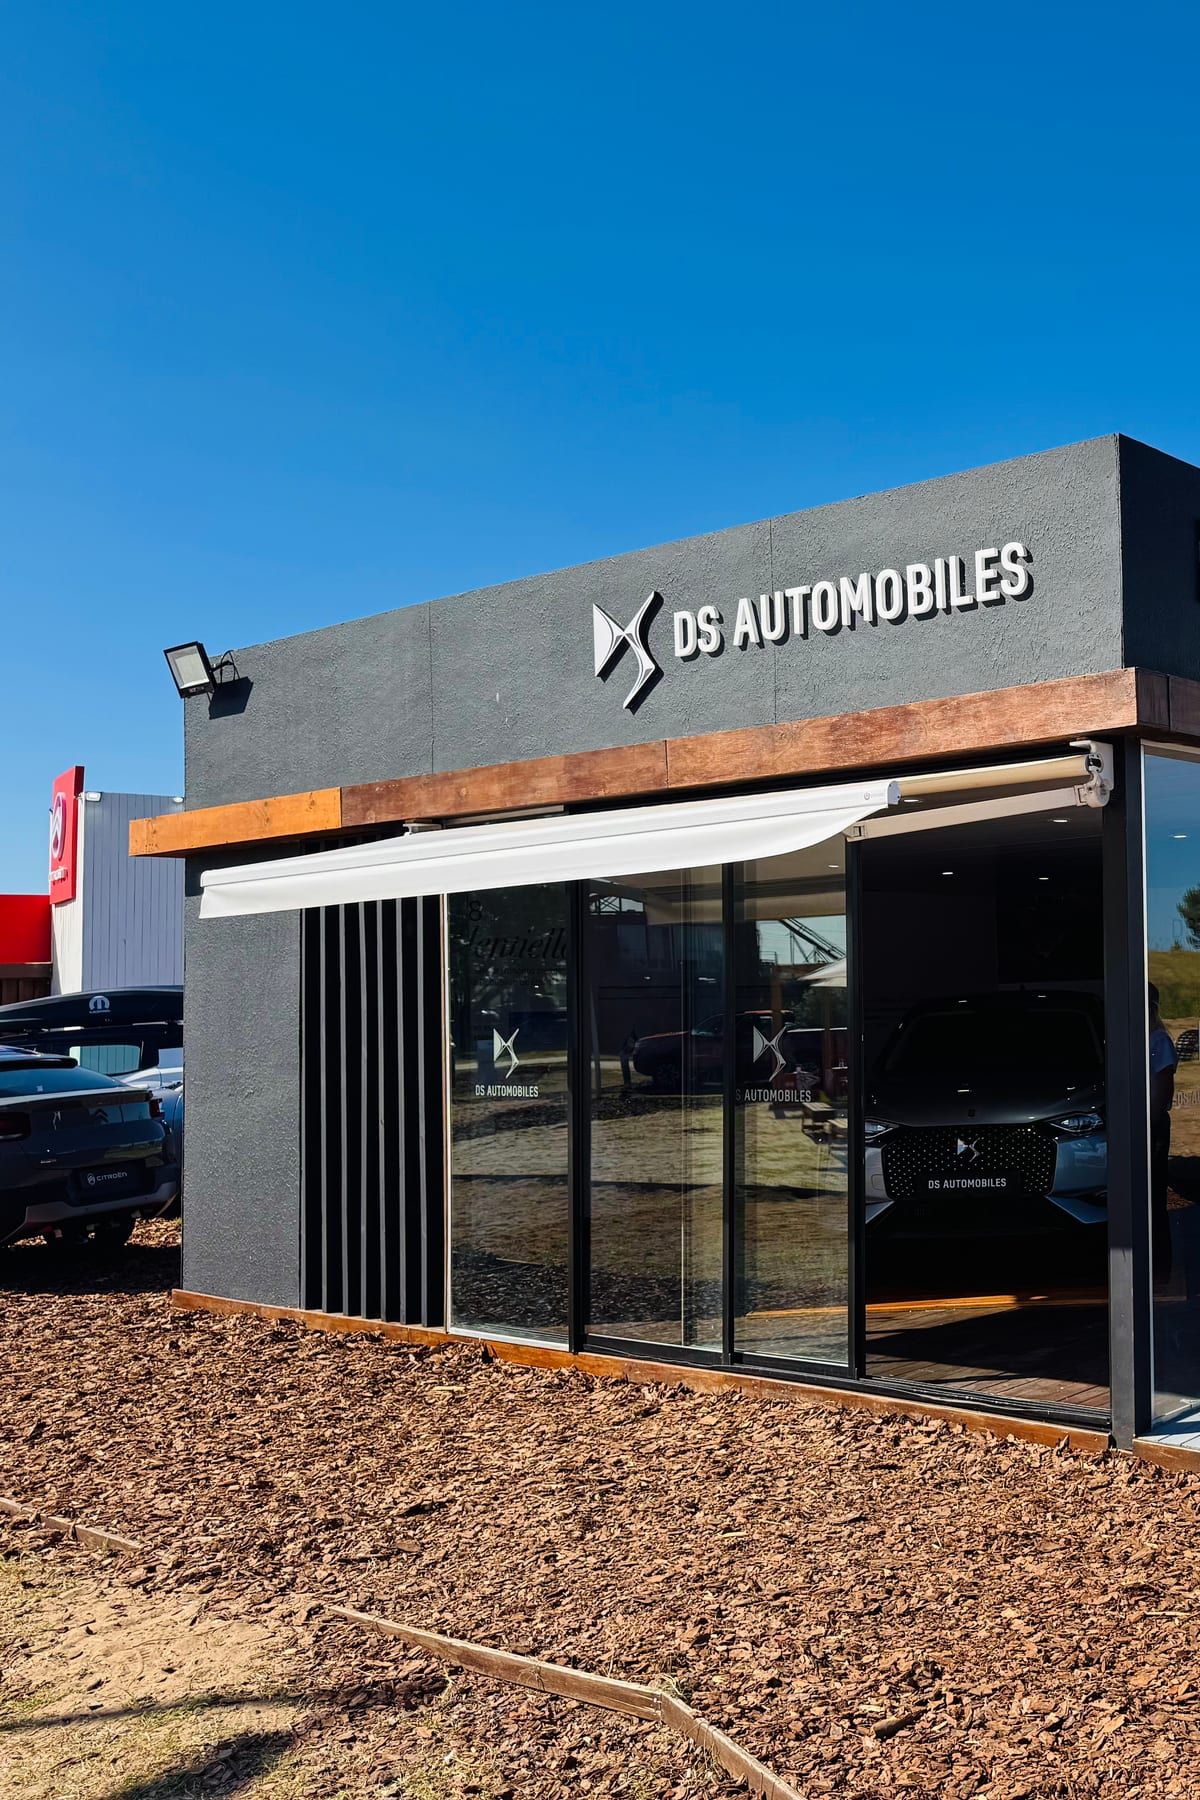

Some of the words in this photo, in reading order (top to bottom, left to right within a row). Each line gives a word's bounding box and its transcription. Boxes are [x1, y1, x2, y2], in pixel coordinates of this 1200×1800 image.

[673, 605, 724, 659] DS
[733, 541, 1030, 648] AUTOMOBILES
[475, 1084, 485, 1096] DS
[486, 1084, 539, 1097] AUTOMOBILES
[744, 1088, 812, 1102] AUTOMOBILES
[928, 1179, 940, 1189] DS
[943, 1177, 1007, 1189] AUTOMOBILES
